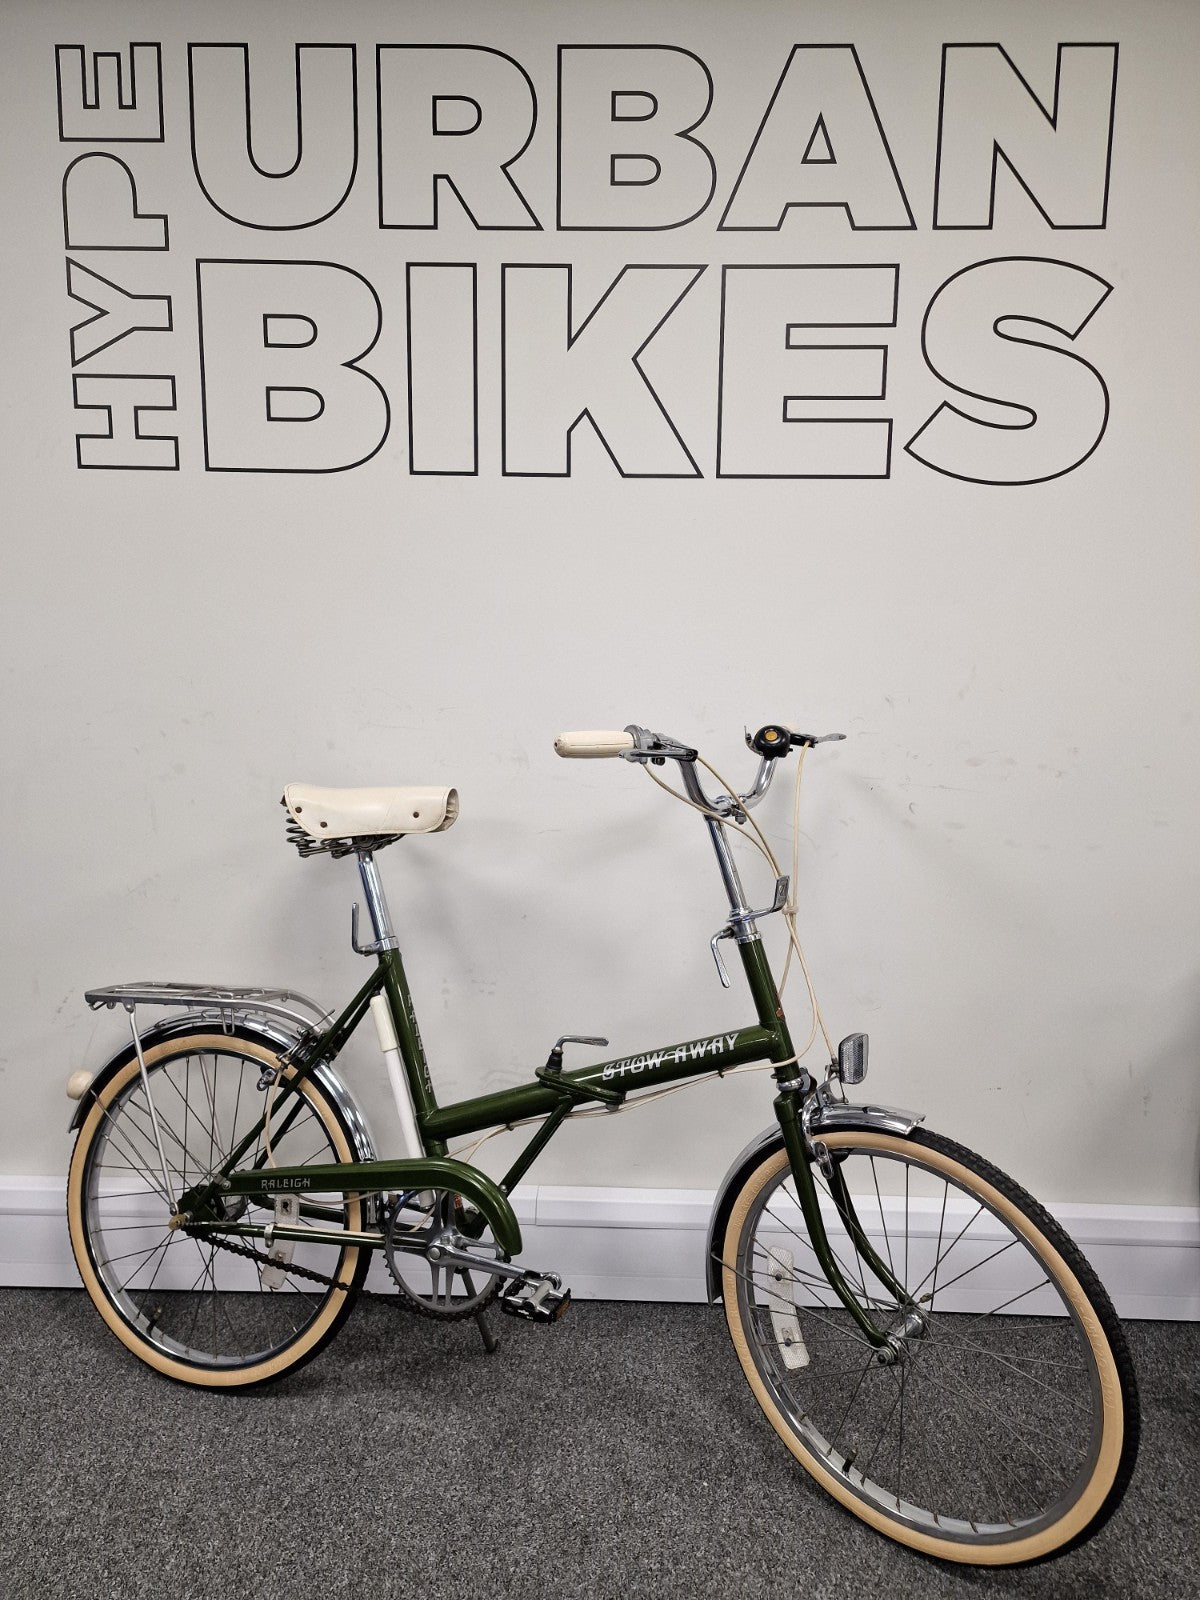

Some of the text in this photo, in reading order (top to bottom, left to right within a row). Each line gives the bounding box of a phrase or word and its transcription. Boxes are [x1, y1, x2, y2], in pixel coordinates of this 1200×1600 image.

[187, 43, 1120, 230] URBAN
[55, 42, 180, 470] HYPE
[196, 256, 1114, 486] BIKES
[261, 1178, 311, 1190] RALEIGH
